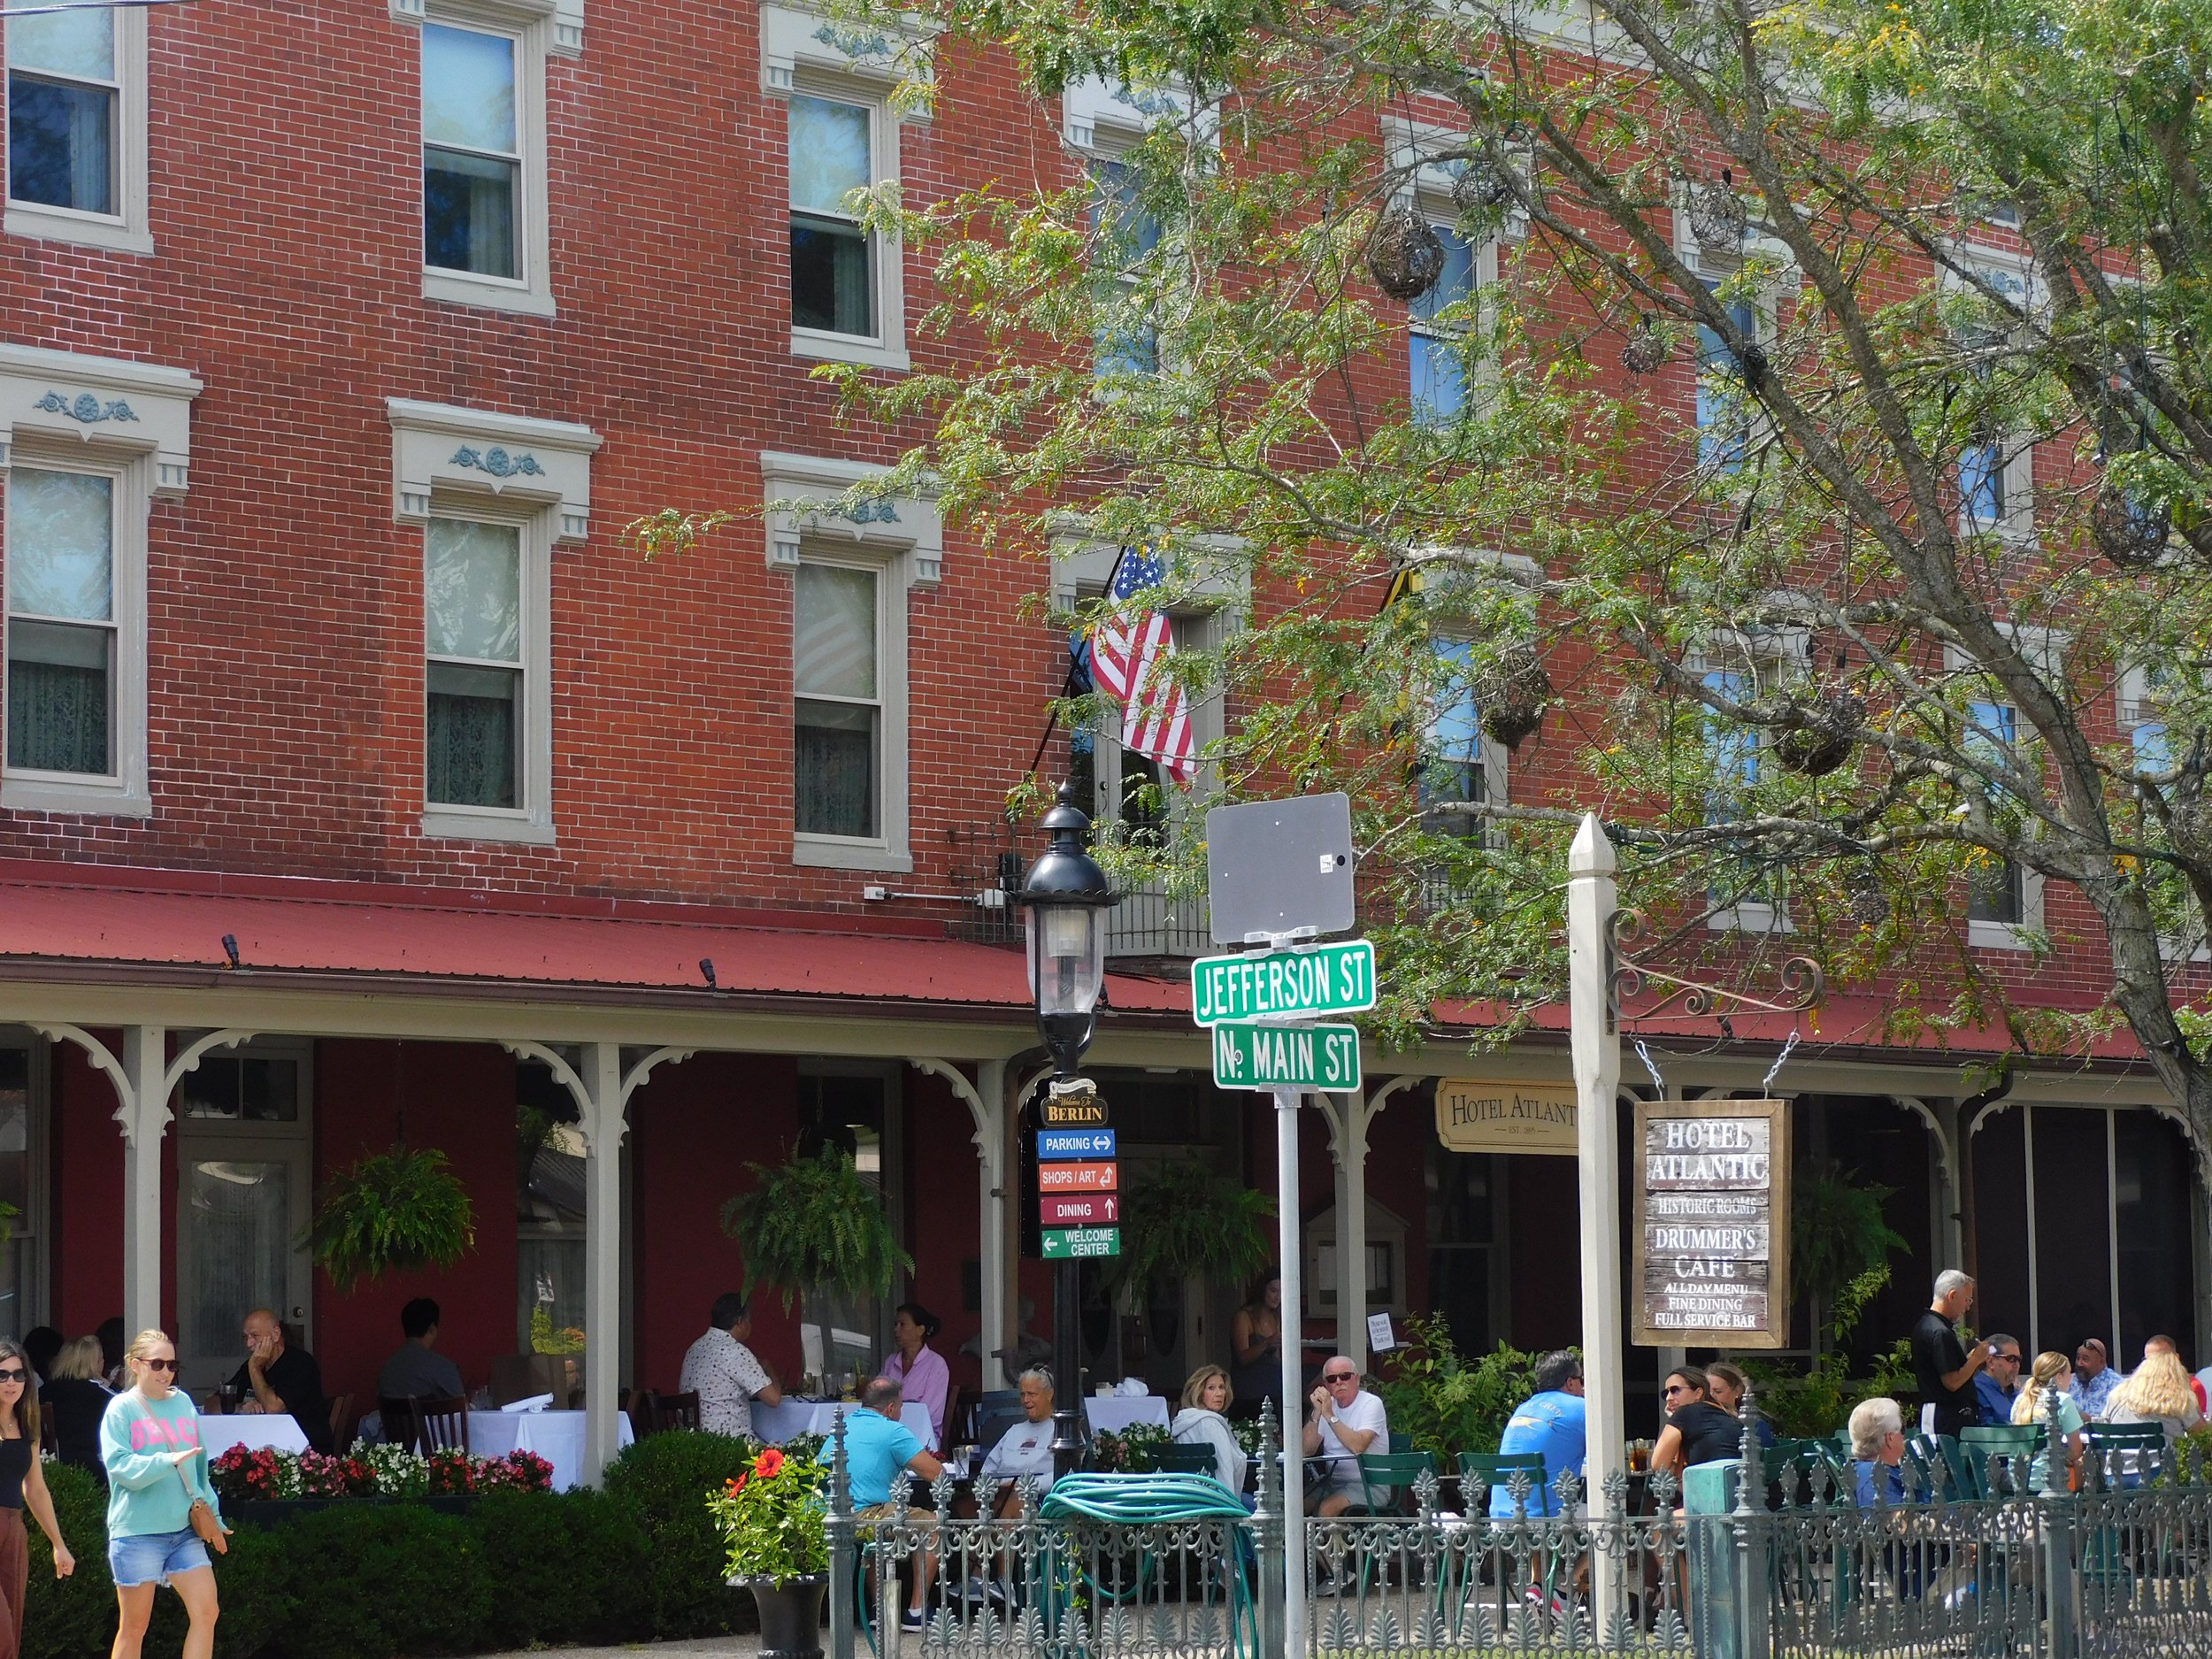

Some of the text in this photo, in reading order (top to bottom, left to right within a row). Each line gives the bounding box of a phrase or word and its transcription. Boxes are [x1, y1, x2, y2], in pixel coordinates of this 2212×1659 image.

[1200, 951, 1366, 1016] JEFFERSON ST
[1252, 1031, 1315, 1081] MAIN
[1325, 1034, 1353, 1082] ST
[1048, 1106, 1103, 1121] BERLIN
[1450, 1092, 1577, 1126] HOTEL ATLANT
[1665, 1122, 1750, 1148] HOTEL
[1046, 1137, 1090, 1151] PARKING
[1651, 1154, 1767, 1180] ATLANTIC
[1042, 1171, 1072, 1184] SHOPS
[1079, 1170, 1096, 1183] ART
[1057, 1203, 1092, 1217] DINING
[1658, 1196, 1756, 1215] HISTORIC ROOMS
[1064, 1229, 1114, 1243] WELCOME
[1655, 1228, 1756, 1250] DRUMMER'S
[1071, 1242, 1110, 1256] CENTER
[1664, 1283, 1748, 1295] ALL DAY MENU
[1669, 1297, 1742, 1310] FINE DINING
[1655, 1313, 1755, 1327] FULL SERVICE BAR
